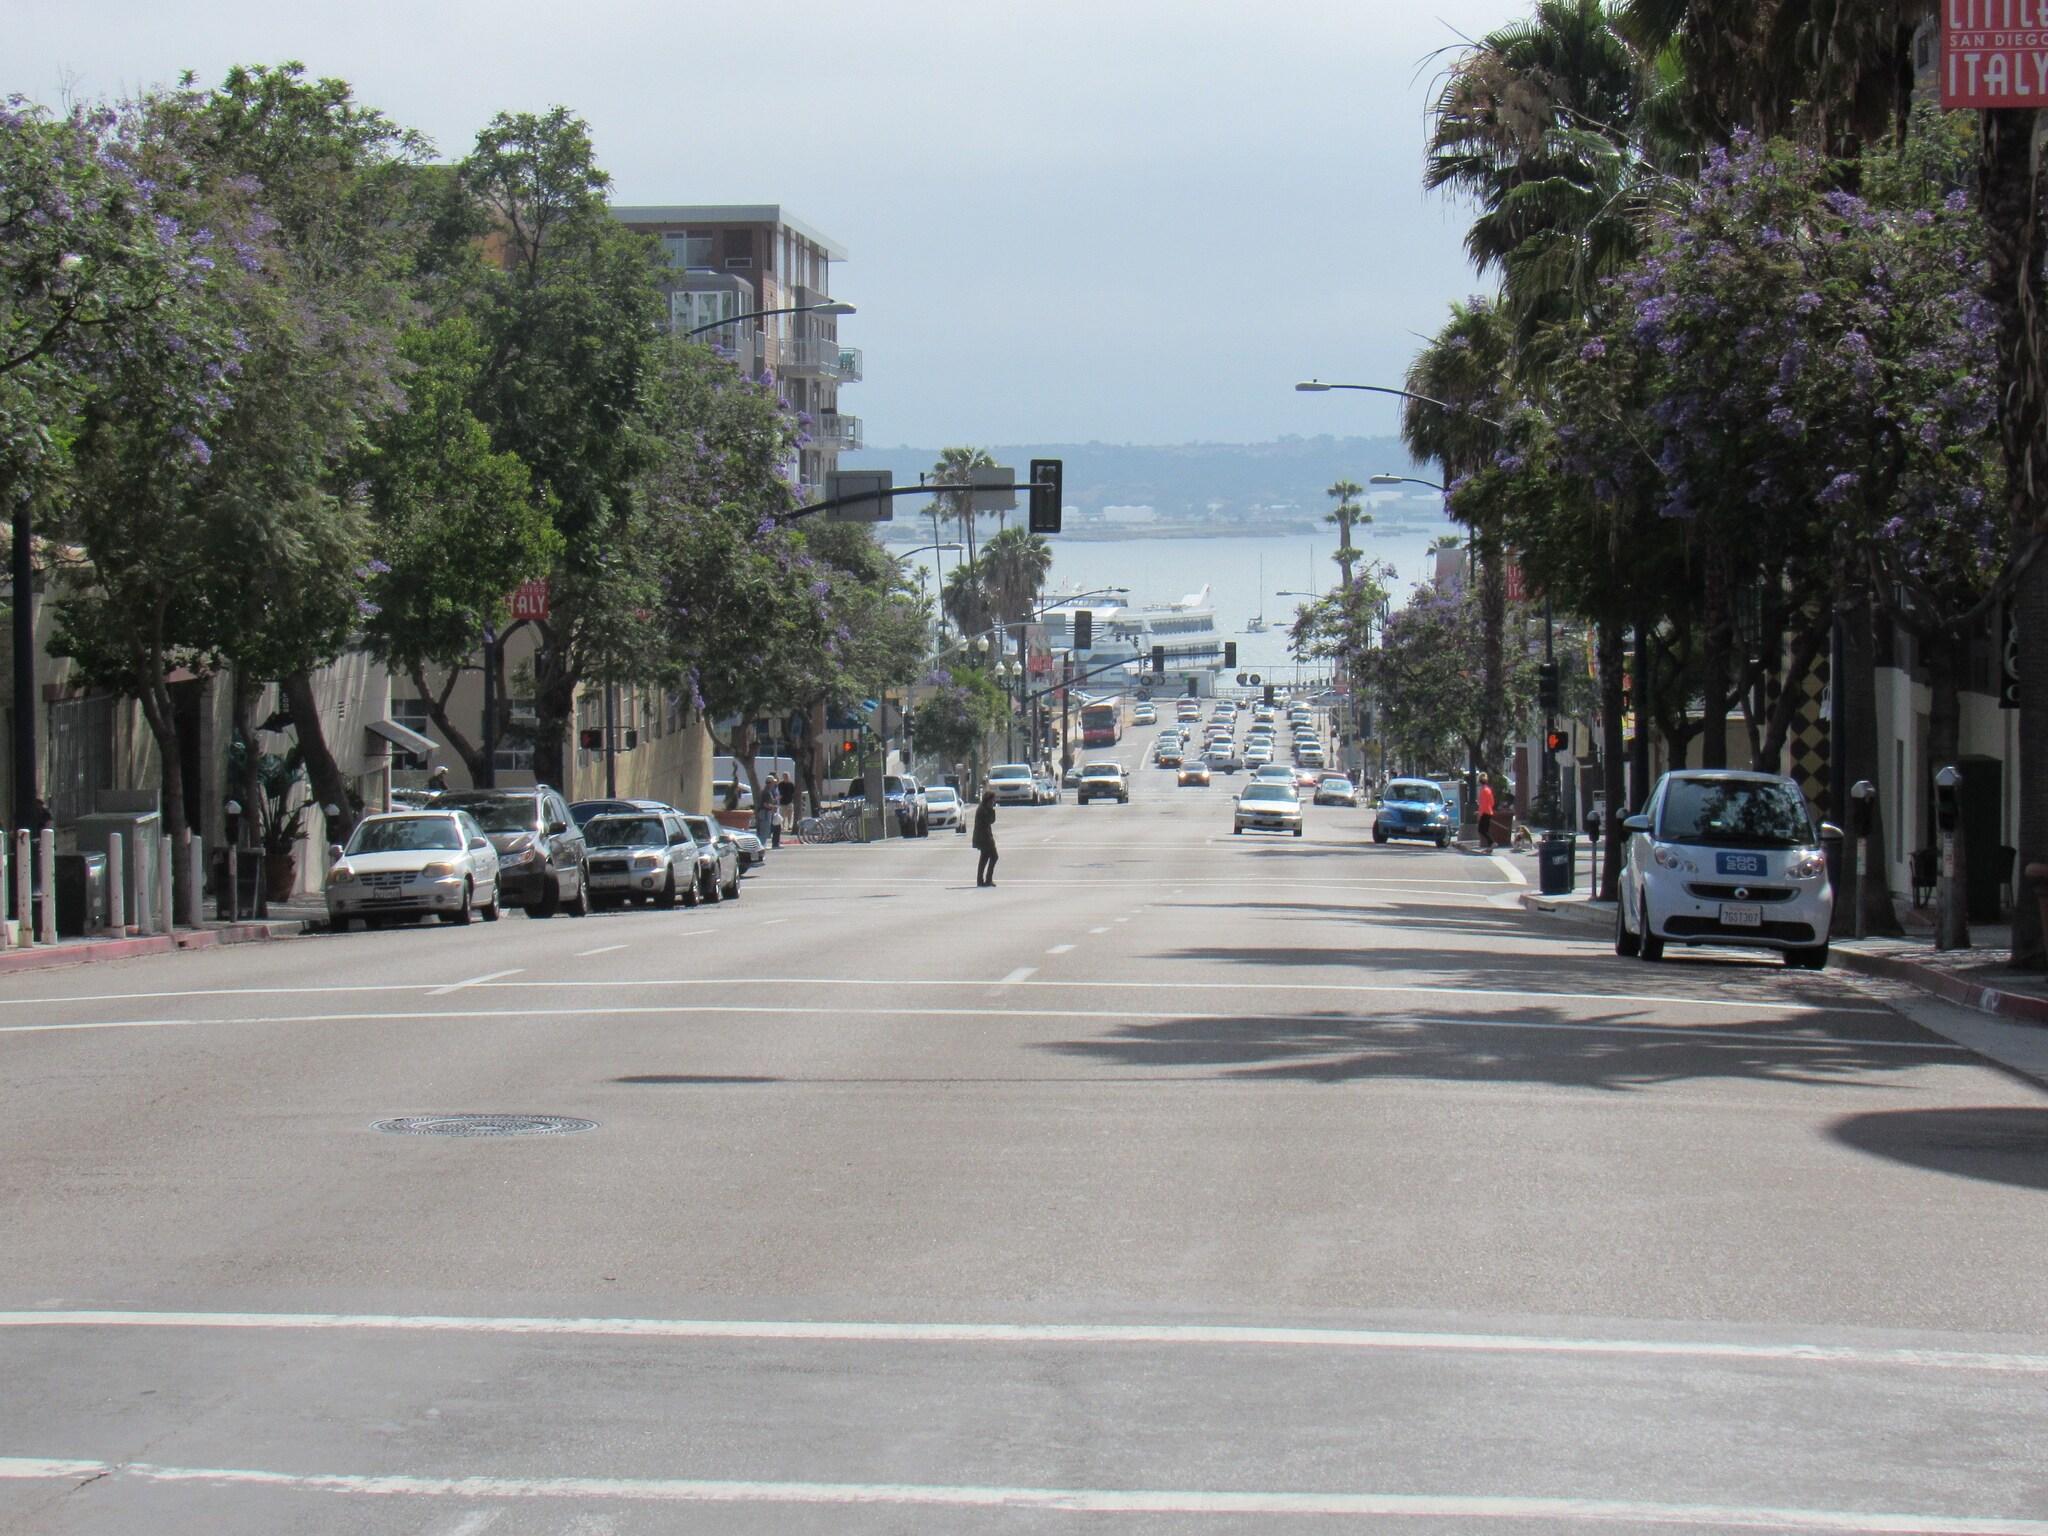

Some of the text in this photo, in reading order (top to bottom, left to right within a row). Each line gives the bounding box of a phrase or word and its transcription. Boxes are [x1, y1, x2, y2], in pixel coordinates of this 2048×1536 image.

[1949, 34, 1985, 47] SAN
[1949, 52, 2048, 96] ITALY
[1726, 855, 1758, 864] CAR
[1726, 862, 1758, 872] 2GO
